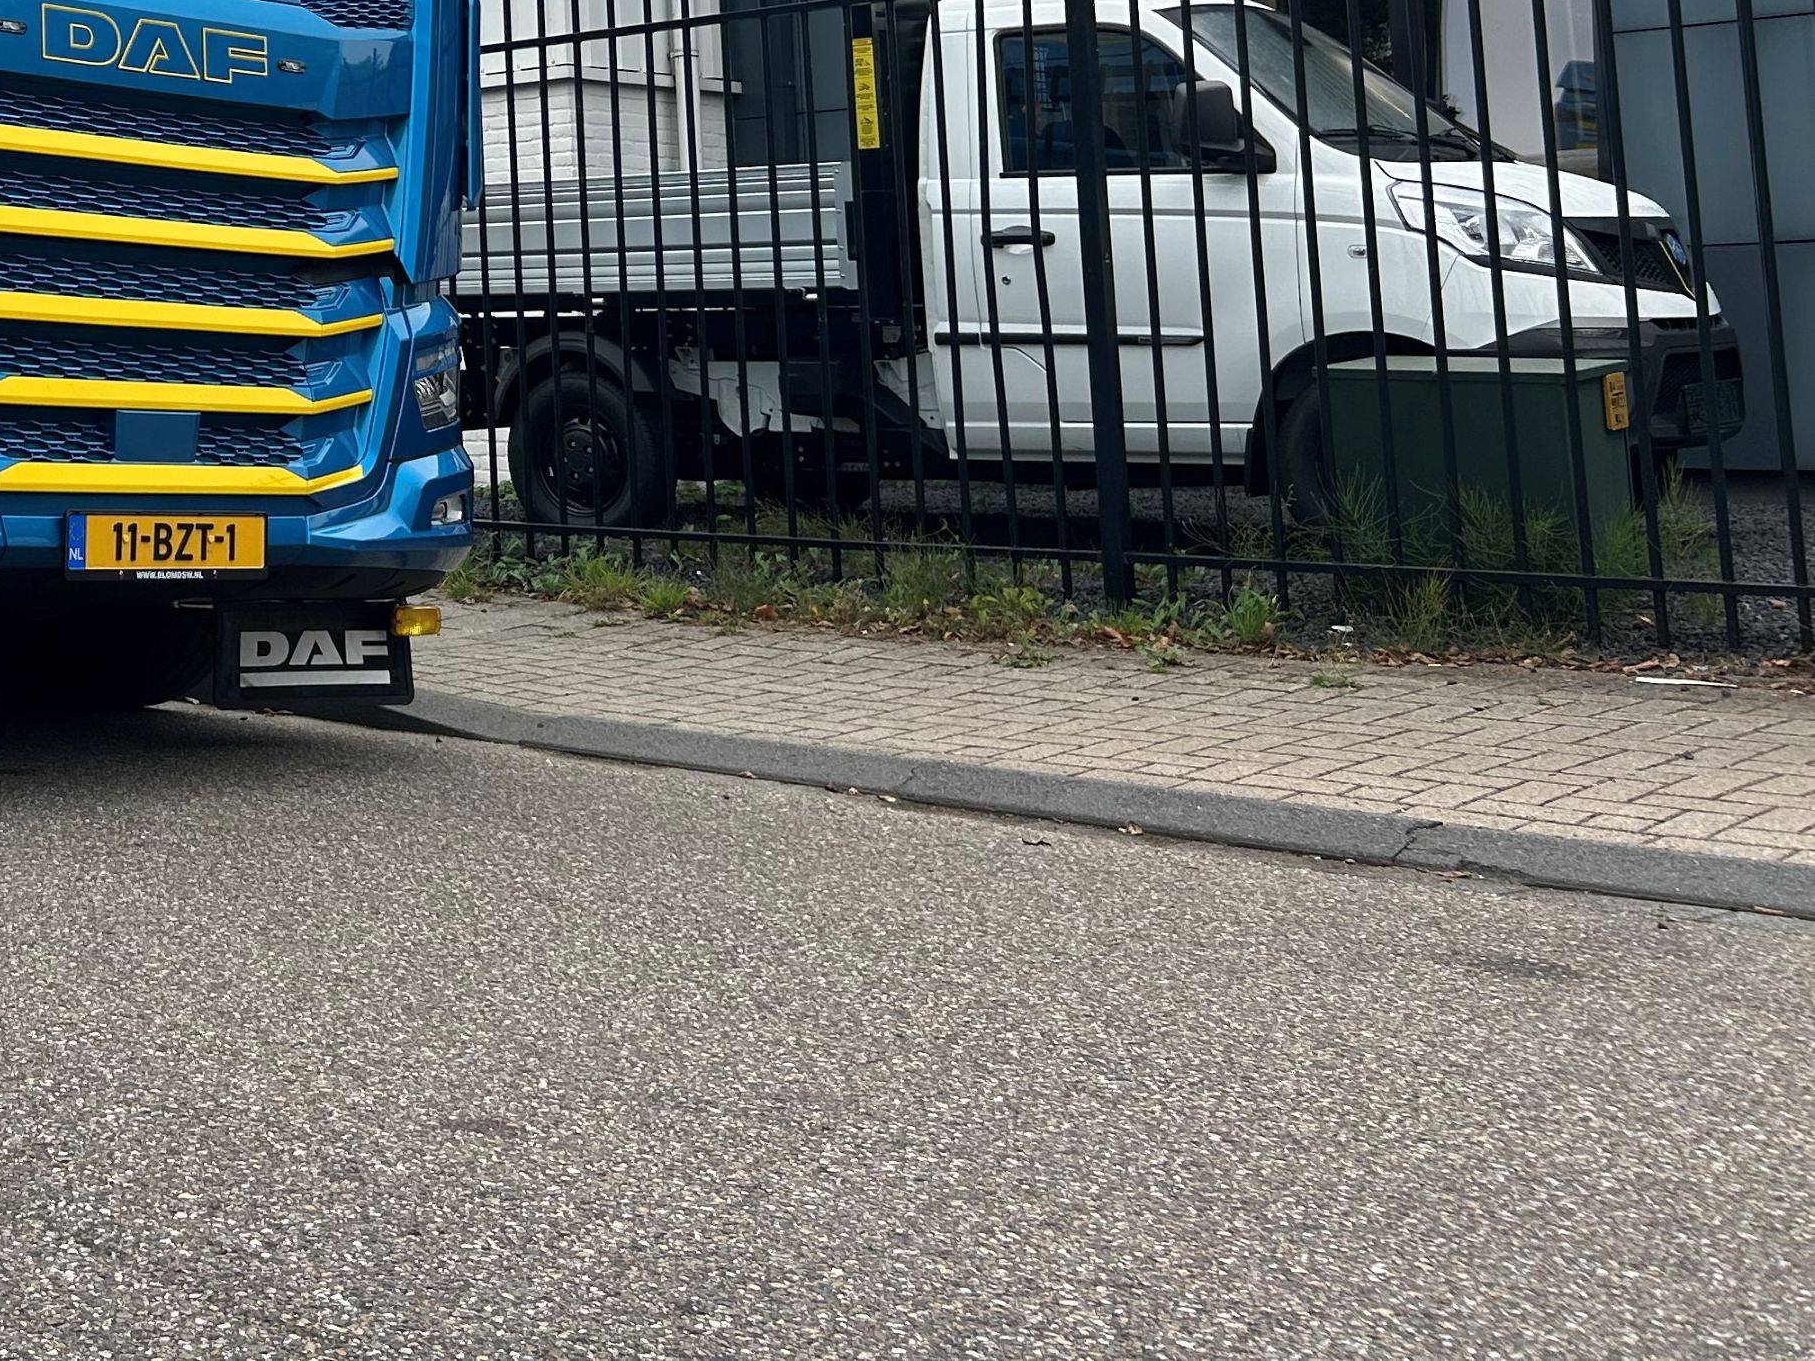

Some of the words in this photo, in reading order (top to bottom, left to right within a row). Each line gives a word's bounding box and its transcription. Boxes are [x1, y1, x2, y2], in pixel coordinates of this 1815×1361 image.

[41, 2, 269, 84] DAF
[69, 547, 84, 561] NL
[113, 522, 236, 562] 11-BZT-1
[239, 629, 389, 667] DAF
